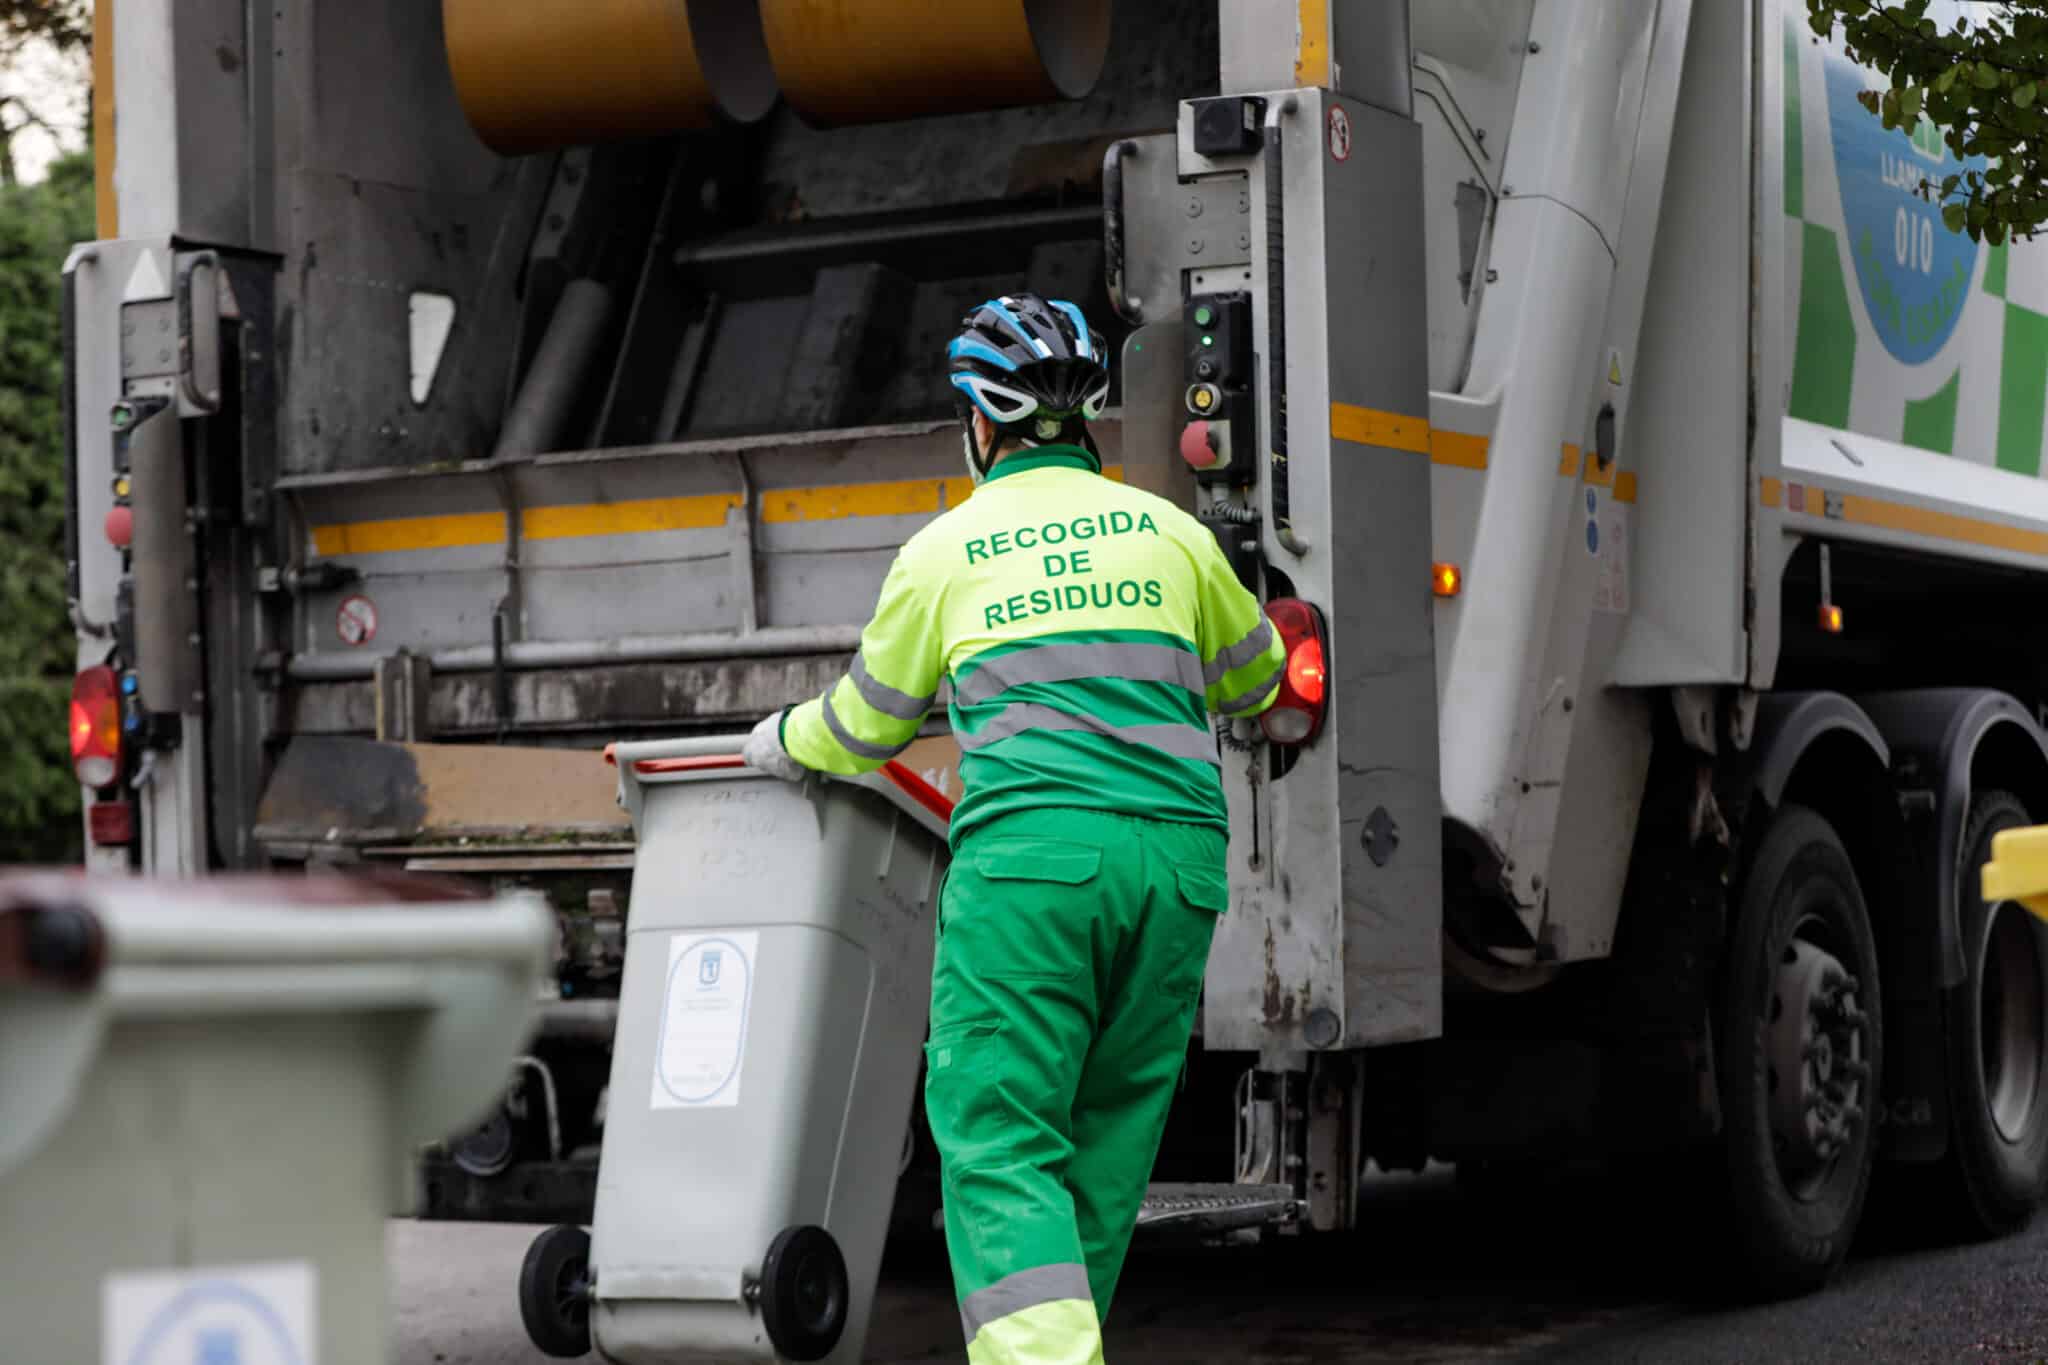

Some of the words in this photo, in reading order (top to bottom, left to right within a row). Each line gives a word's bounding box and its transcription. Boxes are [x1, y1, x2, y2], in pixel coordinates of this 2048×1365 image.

[965, 511, 1160, 565] RECOGIDA
[1042, 549, 1093, 578] DE
[984, 579, 1164, 630] RESIDUOS
